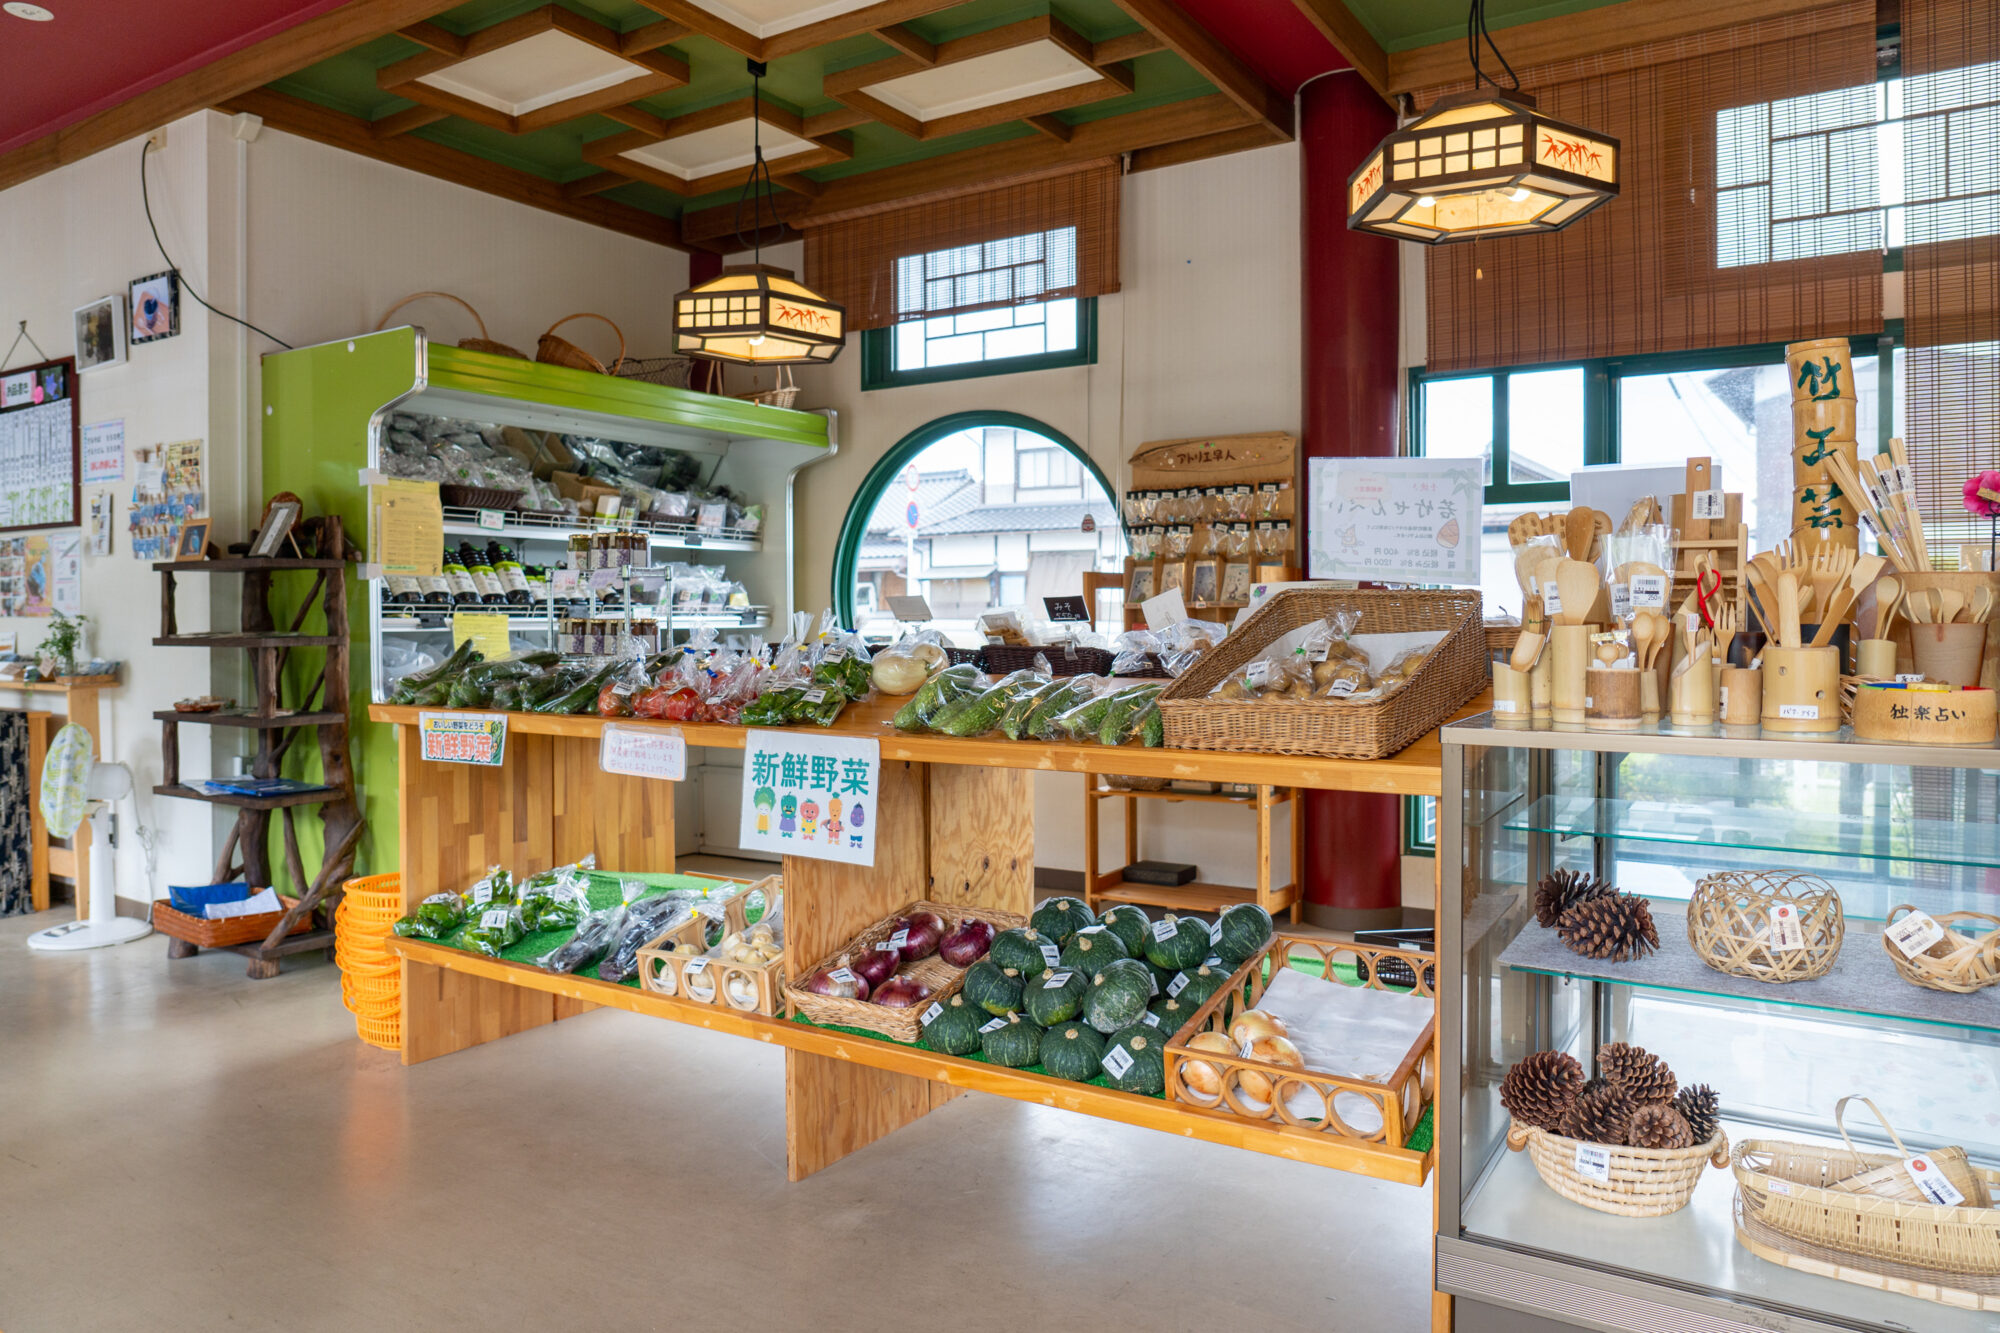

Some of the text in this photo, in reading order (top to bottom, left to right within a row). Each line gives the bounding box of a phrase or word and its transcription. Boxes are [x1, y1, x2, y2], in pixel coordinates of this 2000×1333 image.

[1796, 354, 1843, 529] 竹工芸
[1054, 602, 1071, 611] みそ
[1890, 703, 1966, 722] 独楽占い
[426, 731, 493, 762] 新鮮野菜
[751, 749, 871, 797] 新鮮野菜
